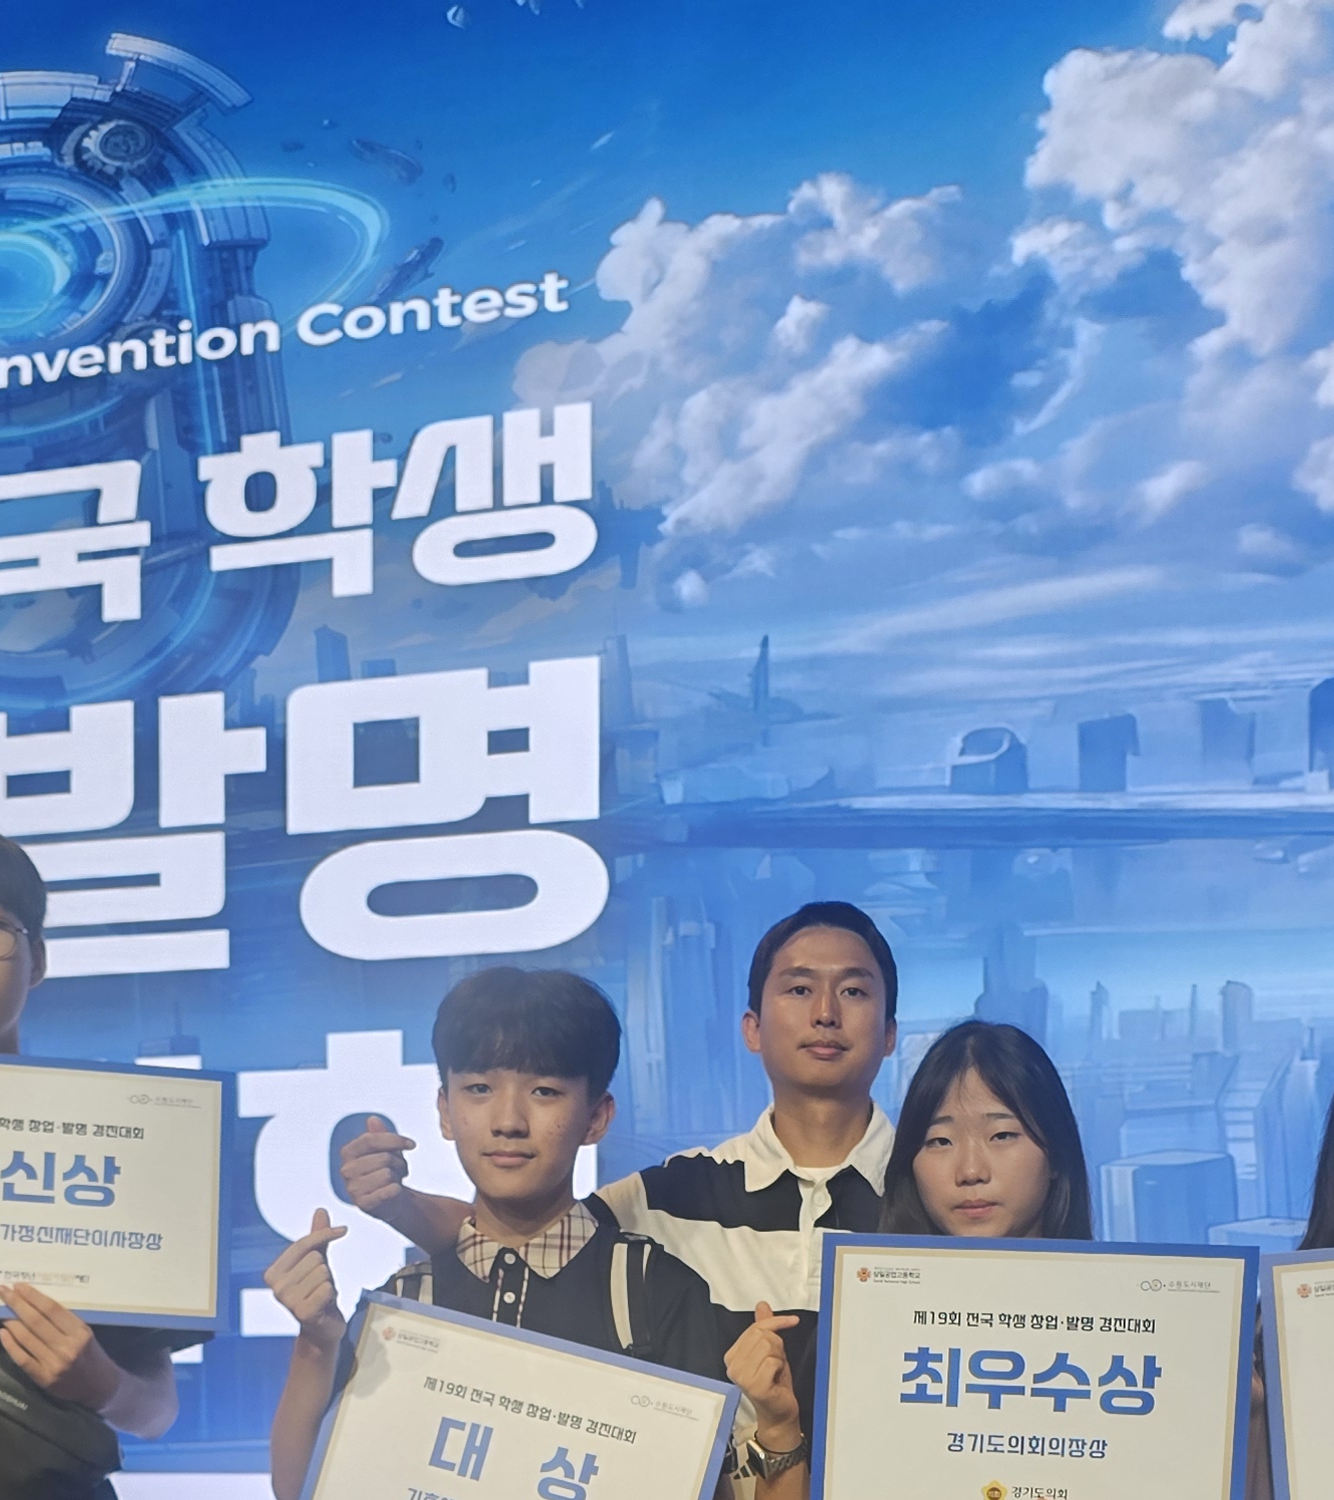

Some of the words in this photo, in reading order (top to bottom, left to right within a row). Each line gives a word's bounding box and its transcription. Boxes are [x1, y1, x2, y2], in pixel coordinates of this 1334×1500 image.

[297, 271, 571, 348] Contest
[198, 402, 599, 600] 학생
[92, 1124, 144, 1140] 경진대회
[966, 1312, 994, 1328] 전국
[998, 1313, 1026, 1329] 학생
[1099, 1317, 1156, 1334] 경진대회
[900, 1346, 1162, 1415] 최우수상
[470, 1388, 494, 1407] 전국
[499, 1395, 523, 1415] 학생
[585, 1417, 637, 1444] 경진대회
[946, 1432, 1108, 1459] 경기도의회의장상
[1011, 1485, 1068, 1500] 경기도의회
